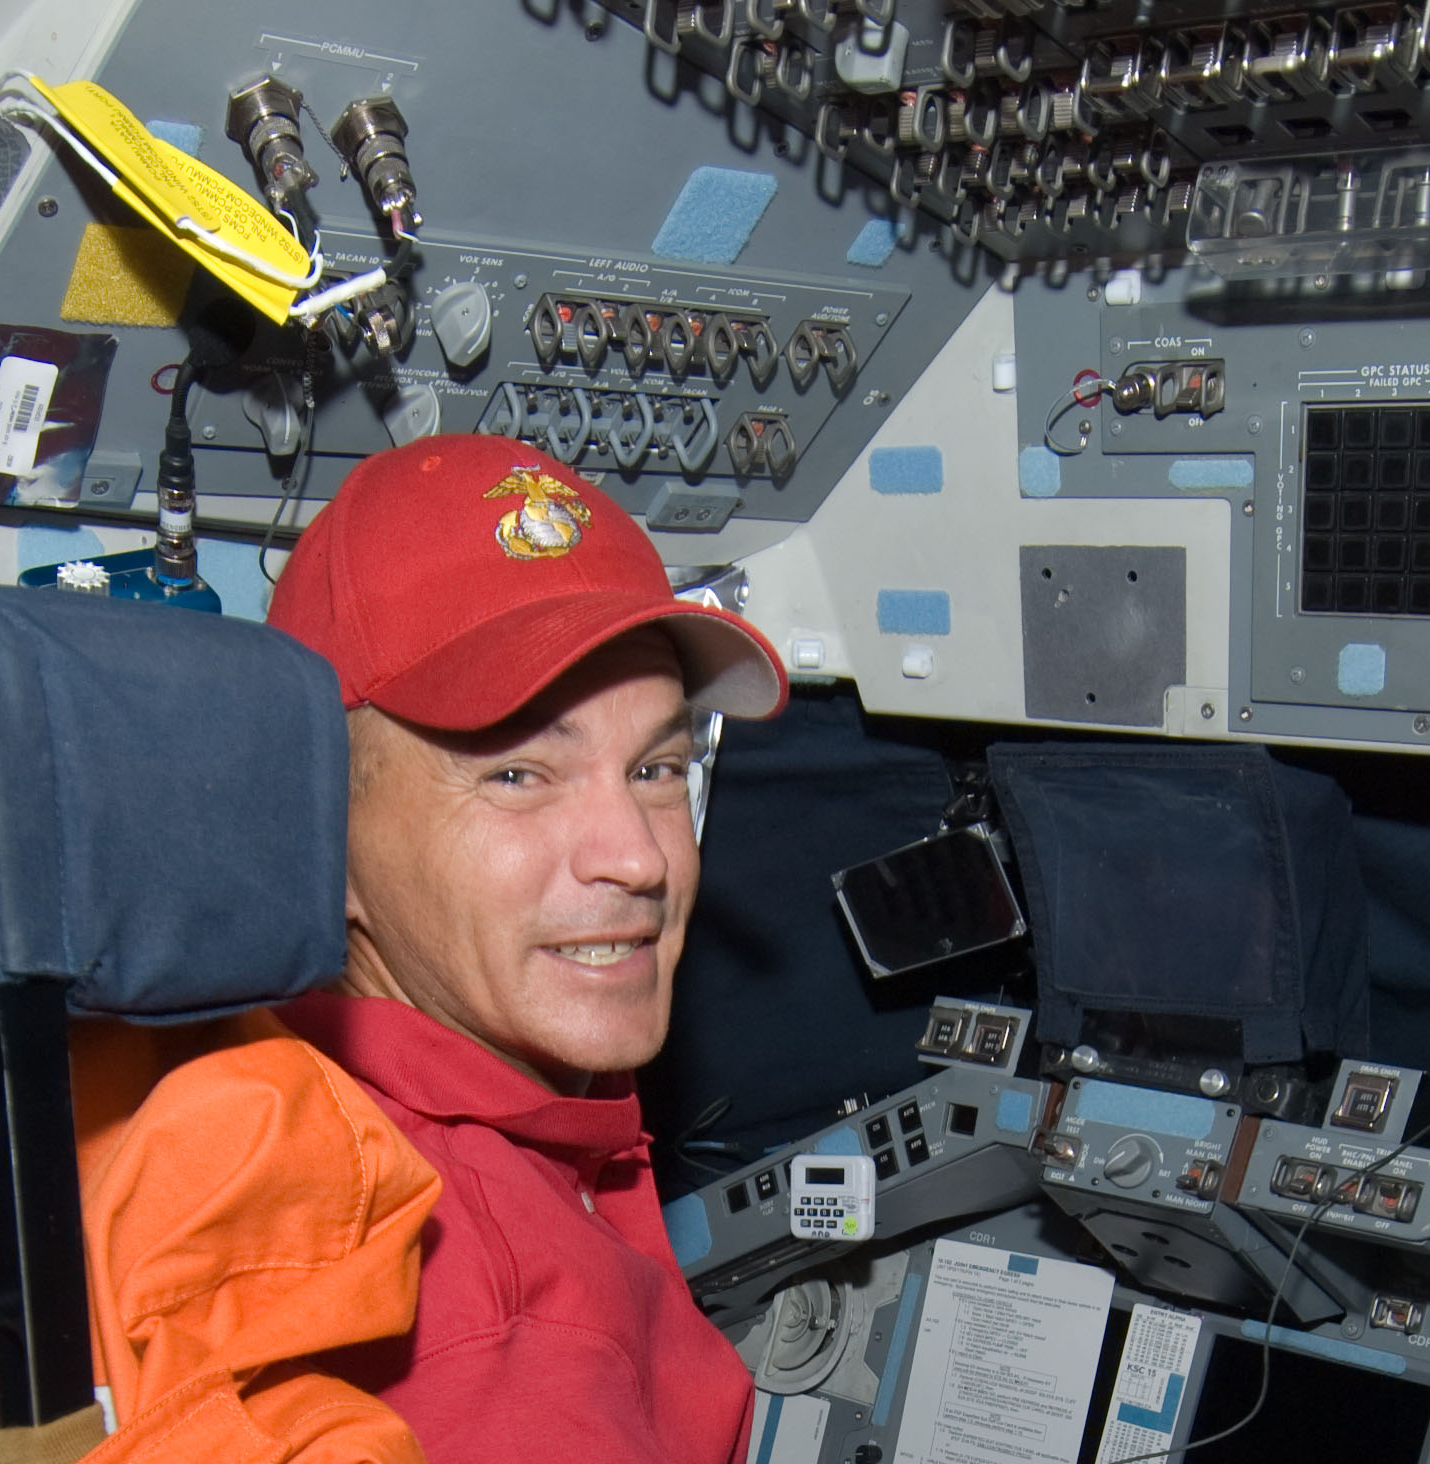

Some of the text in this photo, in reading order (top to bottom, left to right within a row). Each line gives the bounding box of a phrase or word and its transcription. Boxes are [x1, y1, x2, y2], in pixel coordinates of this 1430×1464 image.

[321, 42, 365, 58] PCMMU
[226, 191, 278, 237] WINDECOM
[250, 224, 268, 243] PNL
[459, 254, 503, 266] VOX SENS
[589, 257, 648, 273] LEFT AUDIO
[1155, 337, 1182, 348] COAS
[1191, 347, 1204, 356] ON
[1361, 364, 1430, 376] GPC STATUS
[1370, 376, 1421, 387] FAILED GPC
[1188, 418, 1205, 427] OFF
[1276, 473, 1284, 520] VOTING
[1065, 1116, 1085, 1126] MODE
[1066, 1125, 1080, 1134] TEST
[1194, 1140, 1222, 1151] BRIGHT
[1311, 1136, 1328, 1145] HUD
[1305, 1143, 1332, 1154] POWER
[1185, 1149, 1222, 1161] MAN DAY
[1165, 1193, 1210, 1210] MAN NIGHT
[969, 1231, 996, 1245] CDR1
[1127, 1363, 1148, 1375] KSC
